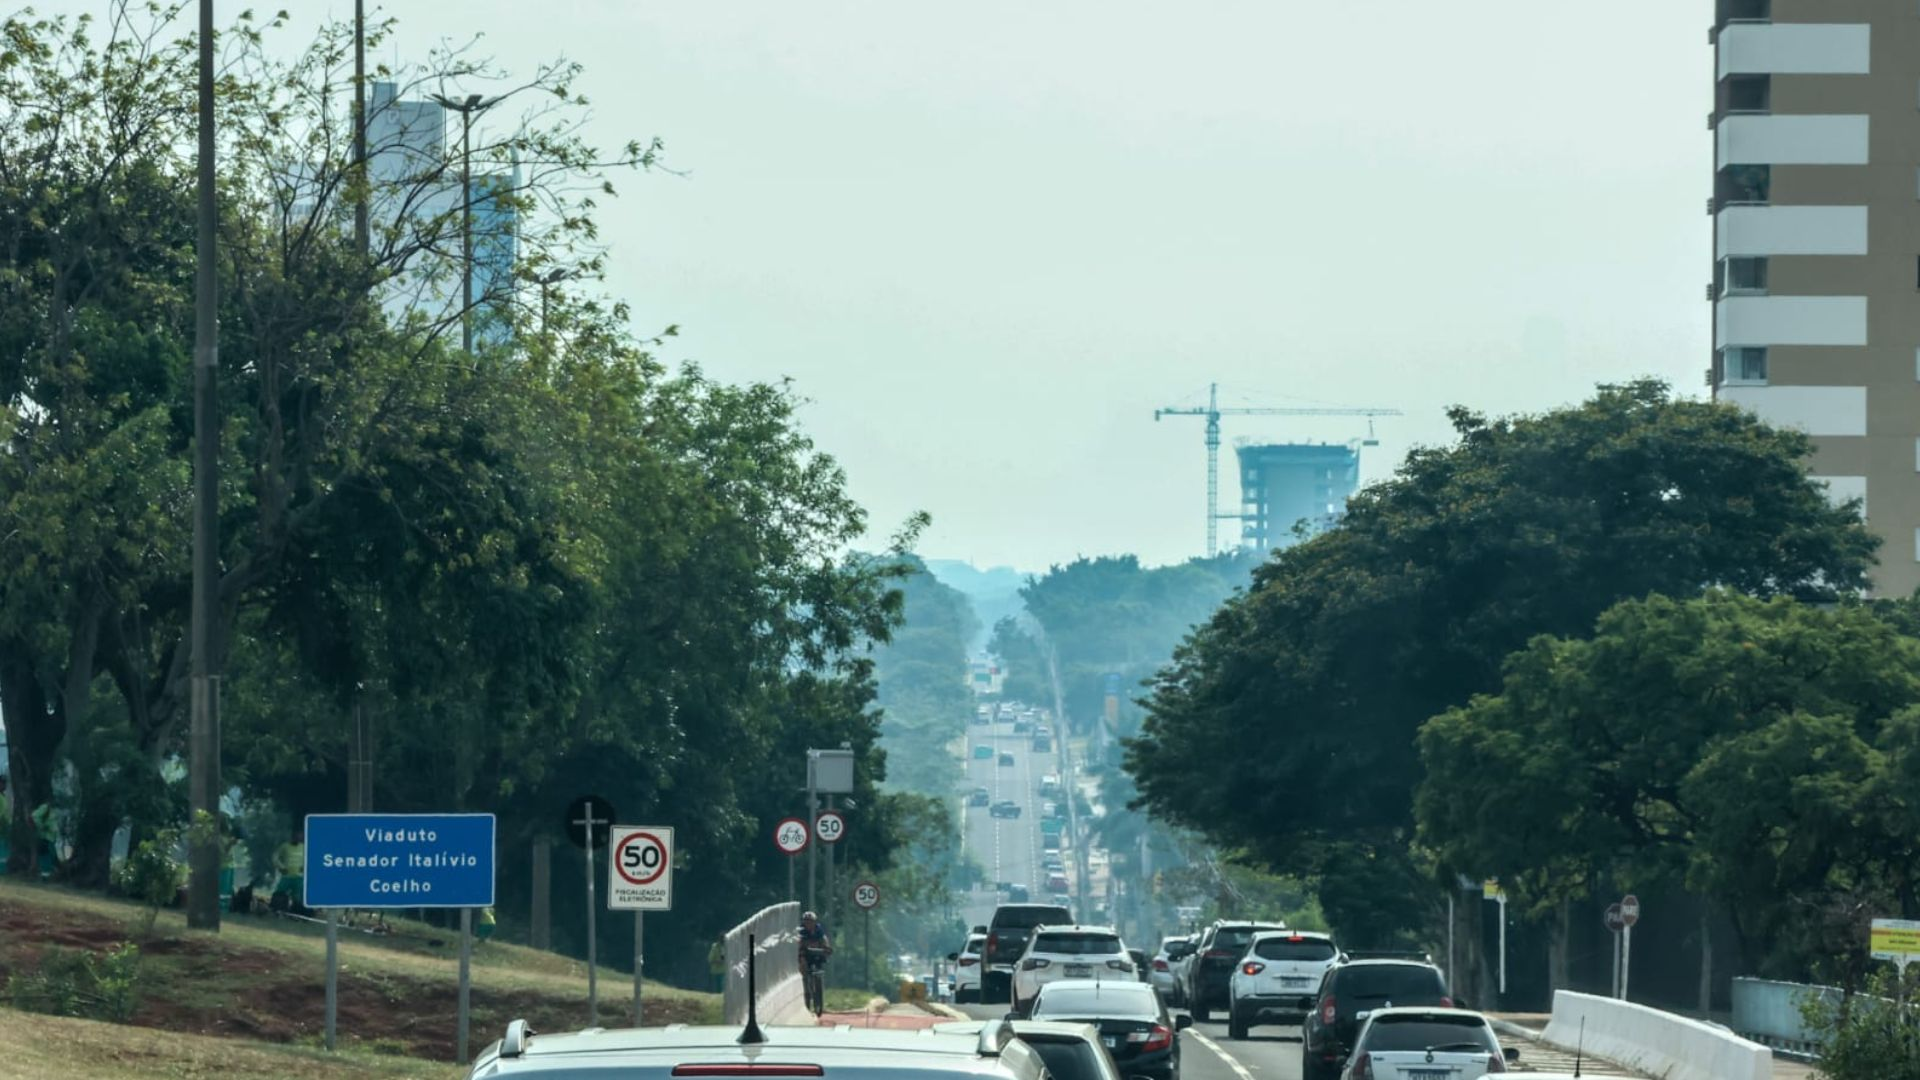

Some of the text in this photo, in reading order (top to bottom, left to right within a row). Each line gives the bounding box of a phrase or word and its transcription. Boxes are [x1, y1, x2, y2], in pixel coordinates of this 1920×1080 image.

[820, 820, 840, 833] 50
[365, 828, 437, 842] Viaduto
[323, 851, 477, 867] Senador Italívio
[624, 846, 659, 868] 50
[370, 879, 432, 892] Coelho
[858, 888, 875, 900] 50
